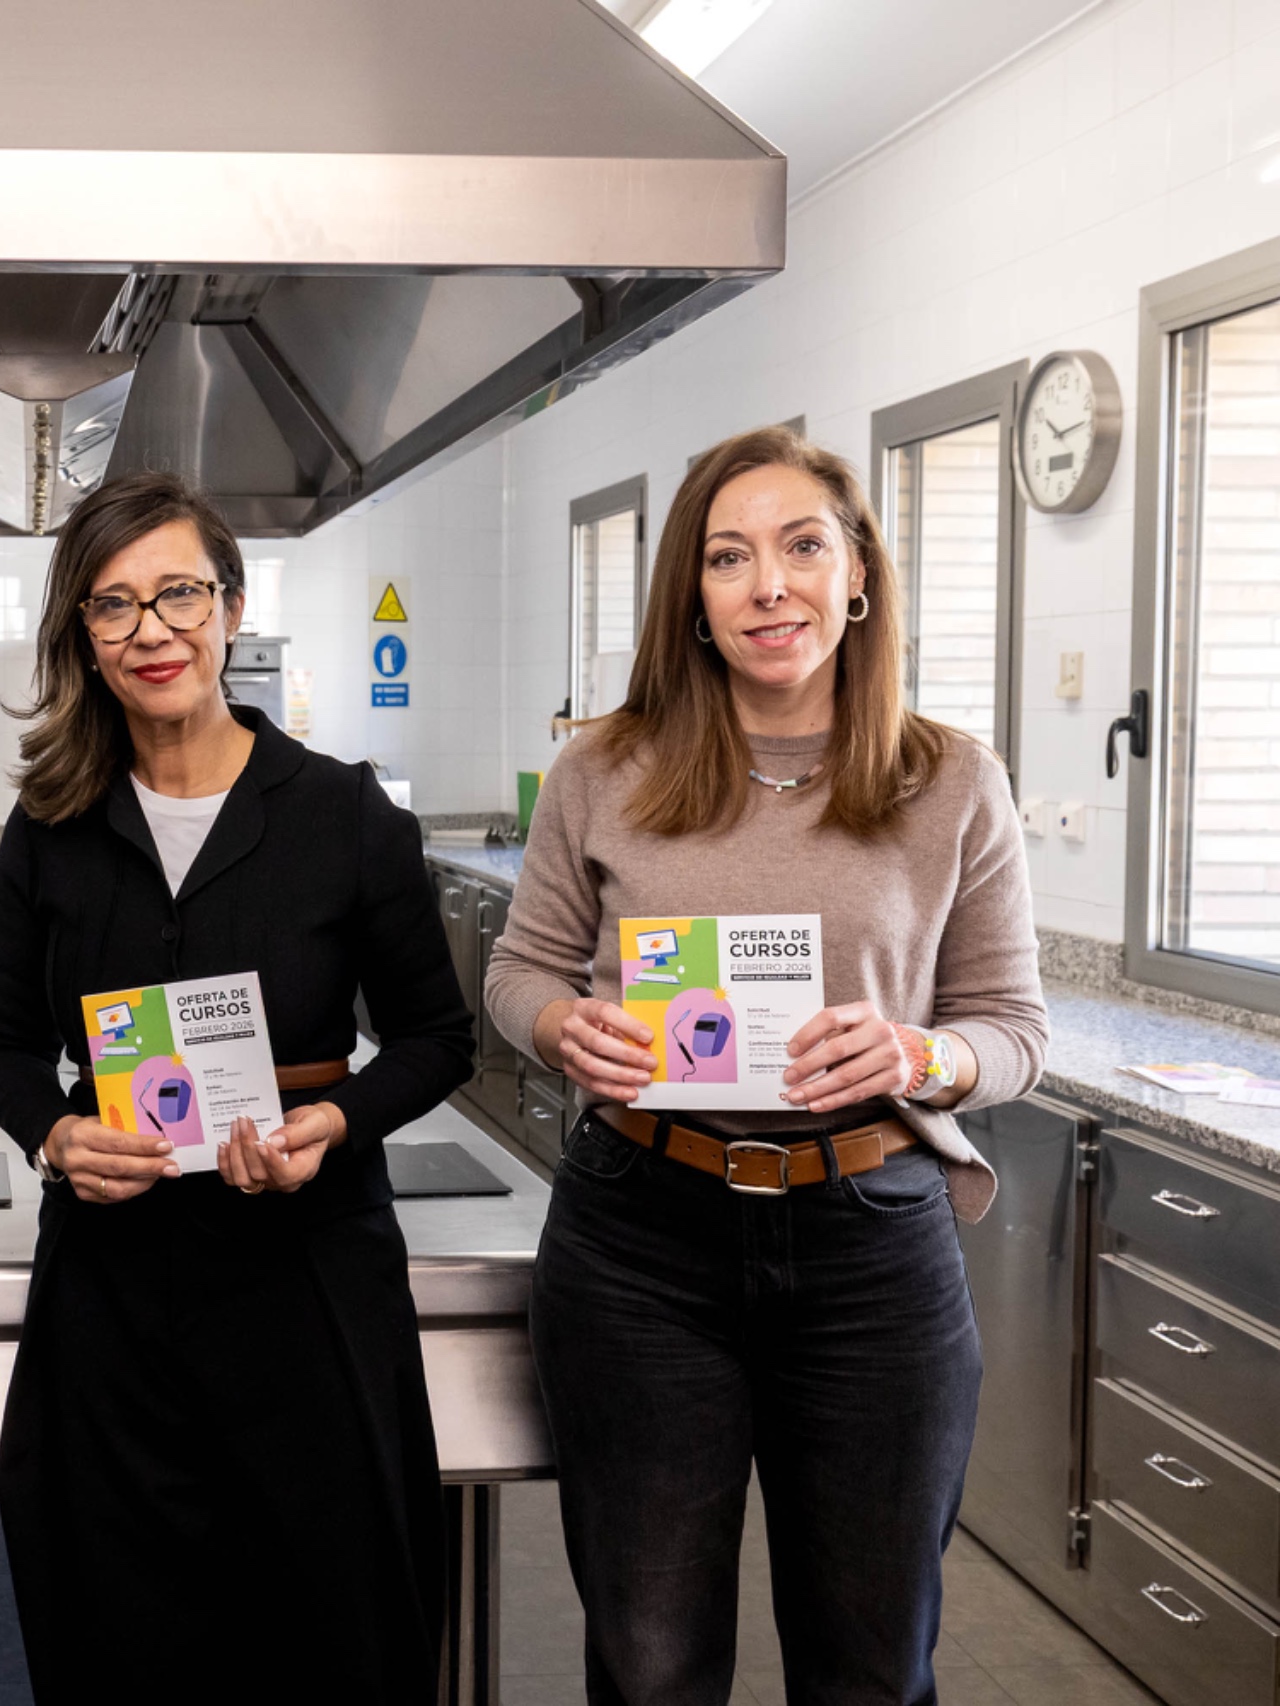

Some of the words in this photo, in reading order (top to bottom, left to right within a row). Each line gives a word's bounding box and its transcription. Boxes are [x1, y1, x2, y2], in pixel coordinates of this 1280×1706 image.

[1058, 372, 1069, 389] 12
[729, 930, 786, 940] OFERTA
[791, 930, 810, 940] DE
[730, 943, 811, 957] CURSOS
[731, 964, 782, 972] FEBRERO
[785, 963, 811, 971] 2026
[177, 991, 227, 1006] OFERTA
[231, 988, 248, 999] DE
[180, 1001, 251, 1022] CURSOS
[183, 1024, 227, 1036] FEBRERO
[231, 1020, 254, 1031] 2026
